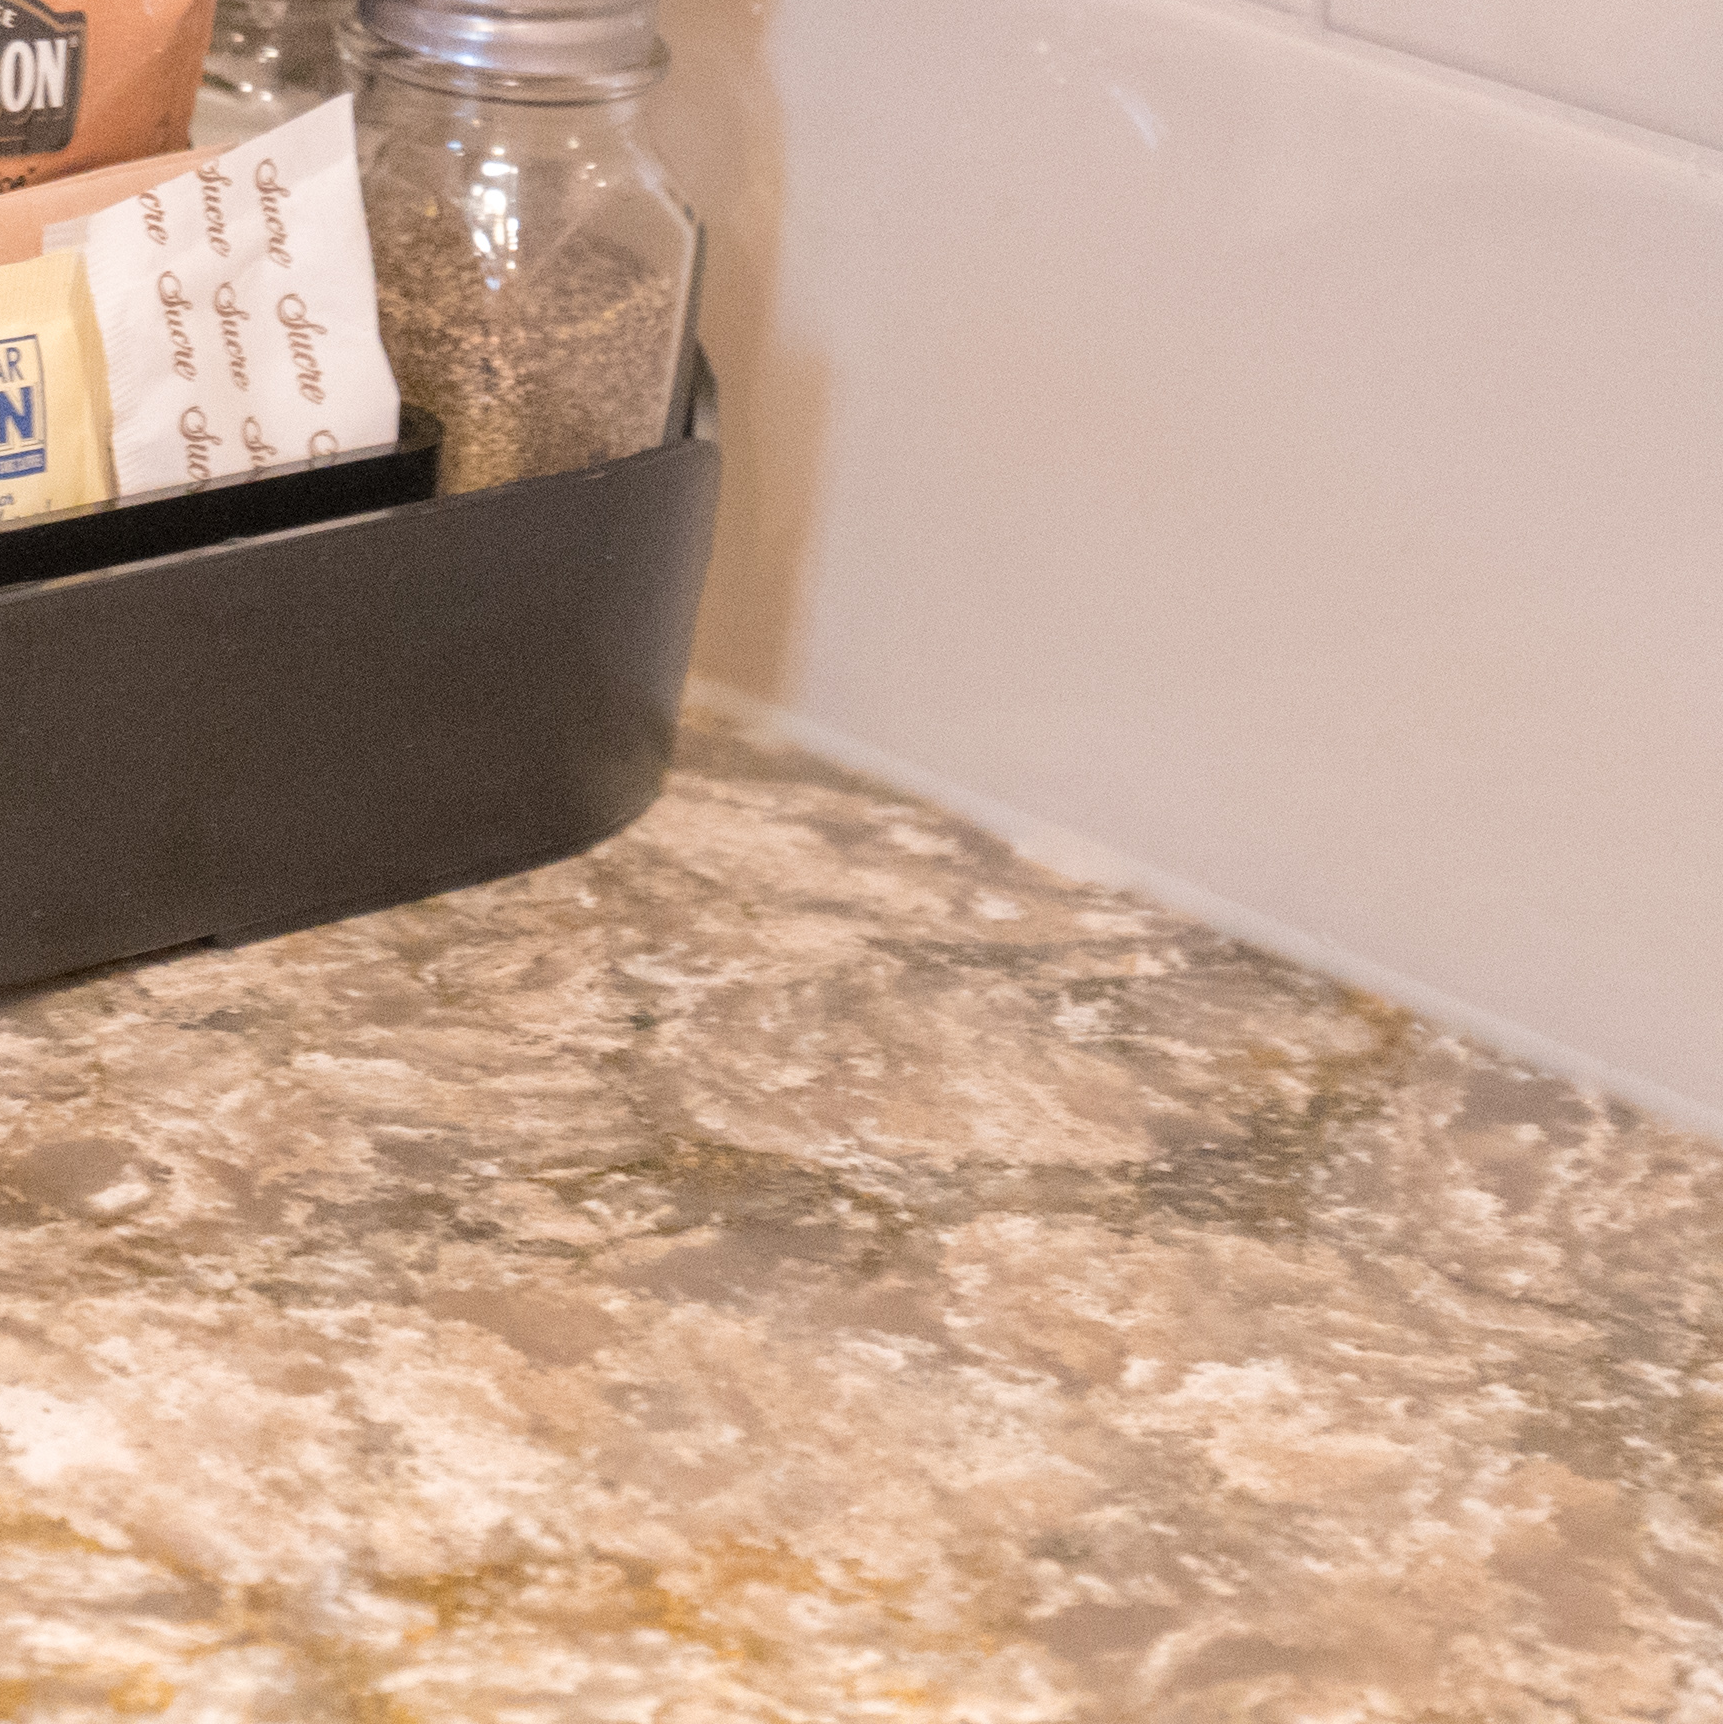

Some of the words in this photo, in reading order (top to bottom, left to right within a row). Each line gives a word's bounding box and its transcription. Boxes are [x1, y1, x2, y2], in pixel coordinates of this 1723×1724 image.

[157, 270, 198, 382] Sucre
[214, 281, 250, 392] Sucre
[255, 158, 294, 269] Sucre
[276, 293, 329, 405] Sucre
